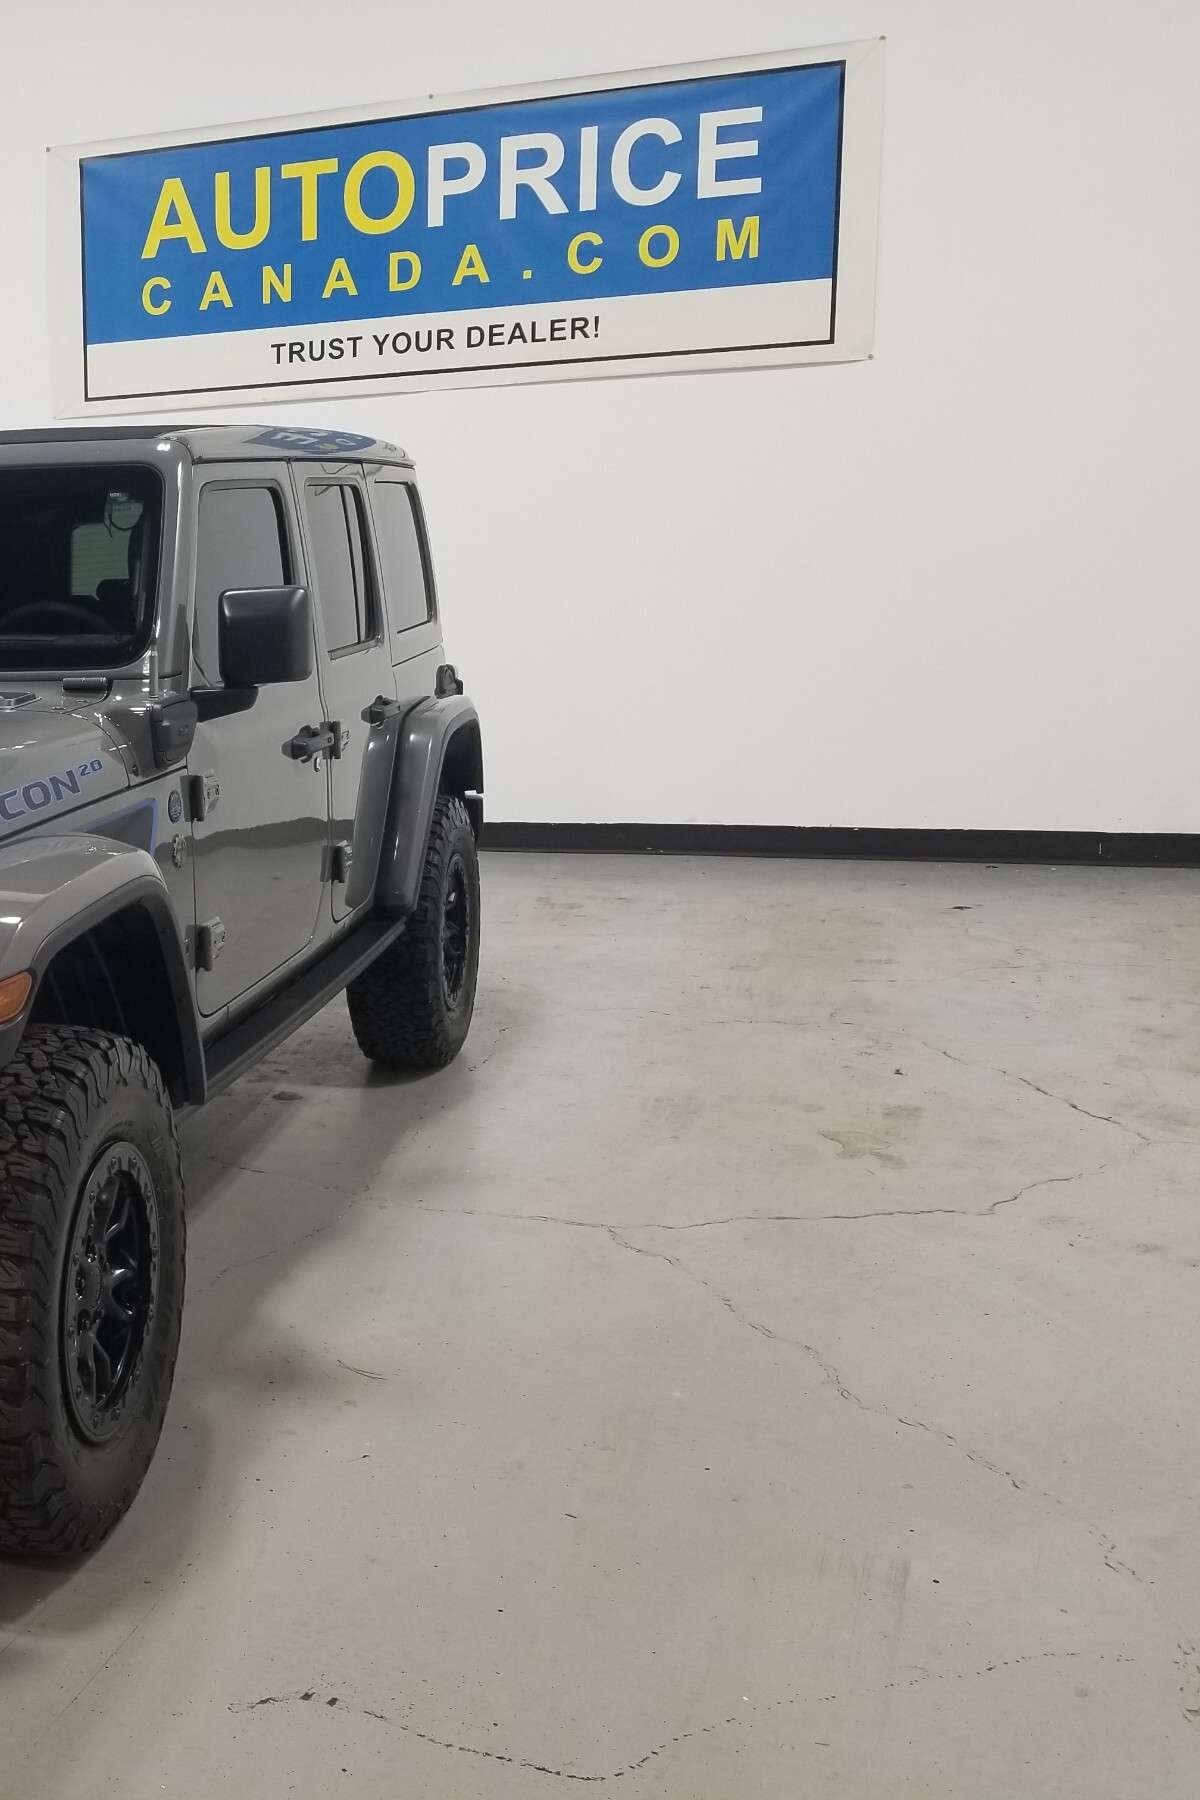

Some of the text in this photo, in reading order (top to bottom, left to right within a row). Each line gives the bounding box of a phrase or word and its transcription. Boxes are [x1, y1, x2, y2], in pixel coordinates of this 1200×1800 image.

[140, 106, 763, 260] AUTOPRICE
[270, 315, 601, 365] TRUST YOUR DEALER!
[78, 759, 103, 777] 20
